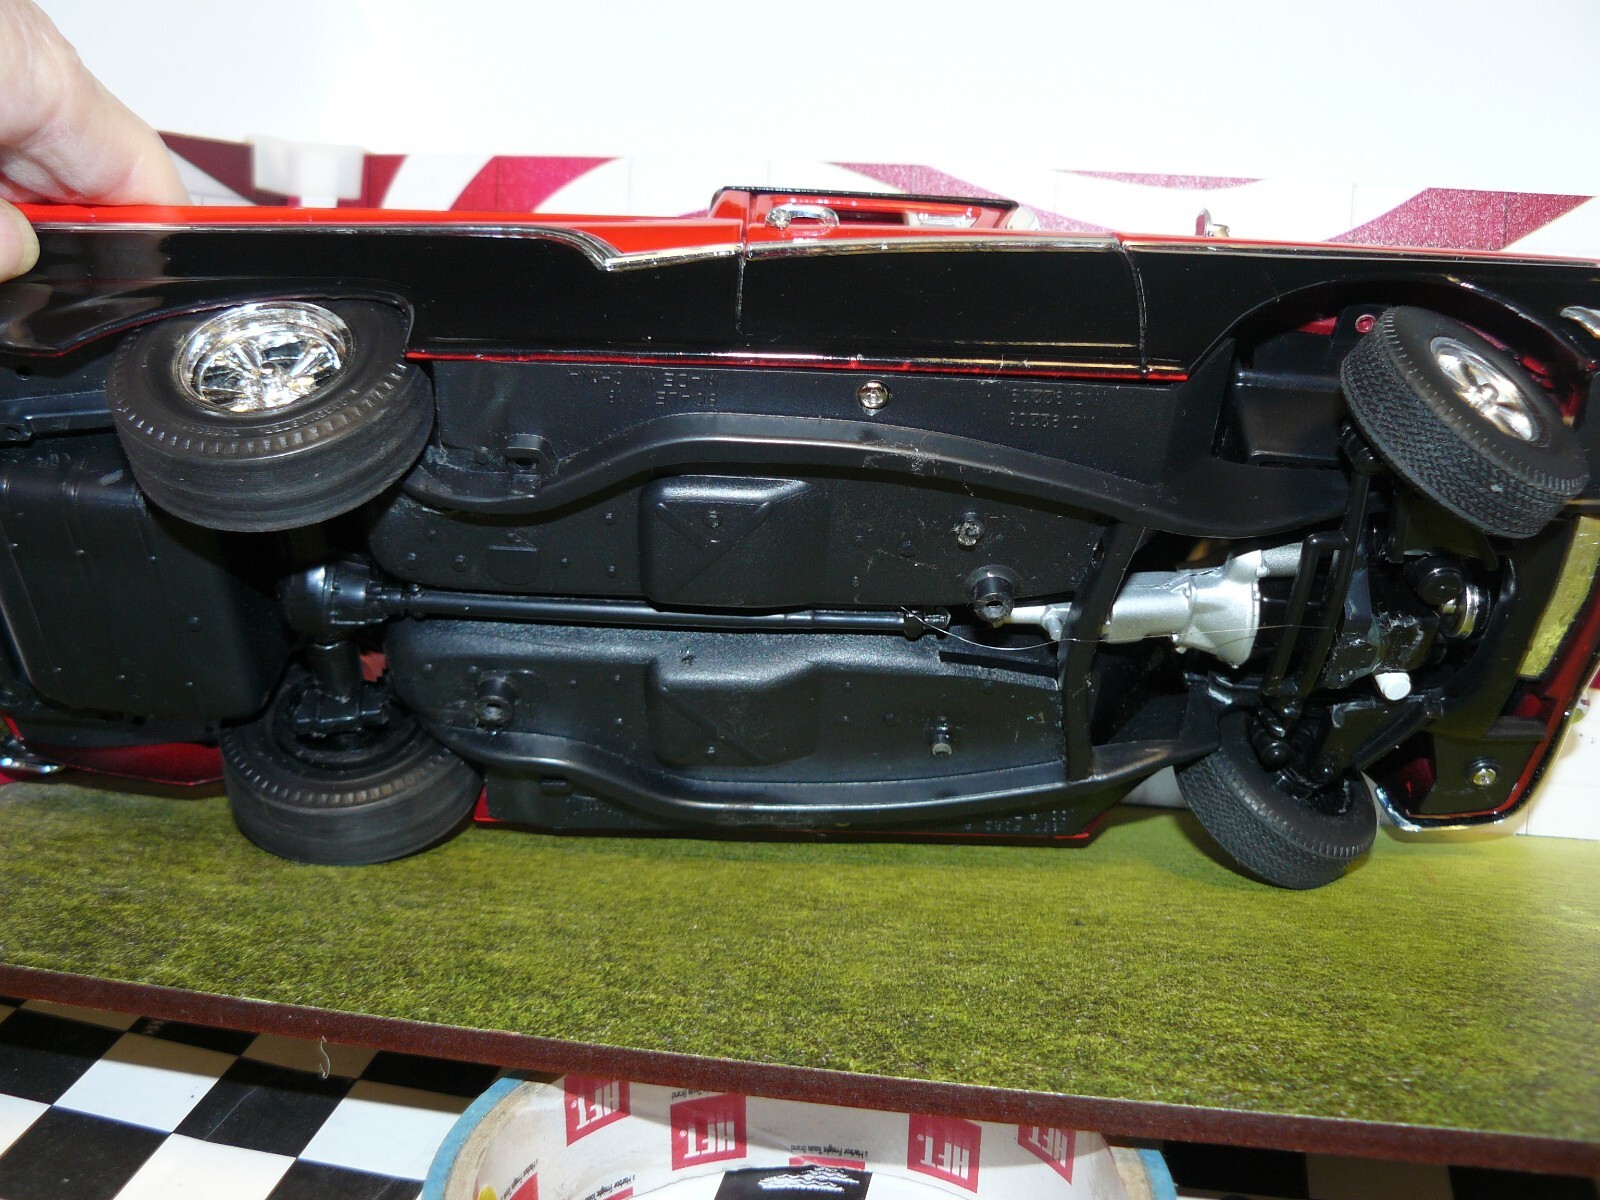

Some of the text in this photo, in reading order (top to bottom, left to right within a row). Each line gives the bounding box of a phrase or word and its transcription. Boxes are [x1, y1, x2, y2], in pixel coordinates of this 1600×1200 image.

[576, 1079, 620, 1131] HFT
[684, 1120, 735, 1159] HFT
[807, 1143, 823, 1155] Tools
[823, 1144, 843, 1157] Freight
[1028, 1126, 1068, 1169] HFT
[843, 1147, 864, 1159] Harbor
[920, 1135, 970, 1180] HFT
[613, 1176, 632, 1189] Harbor
